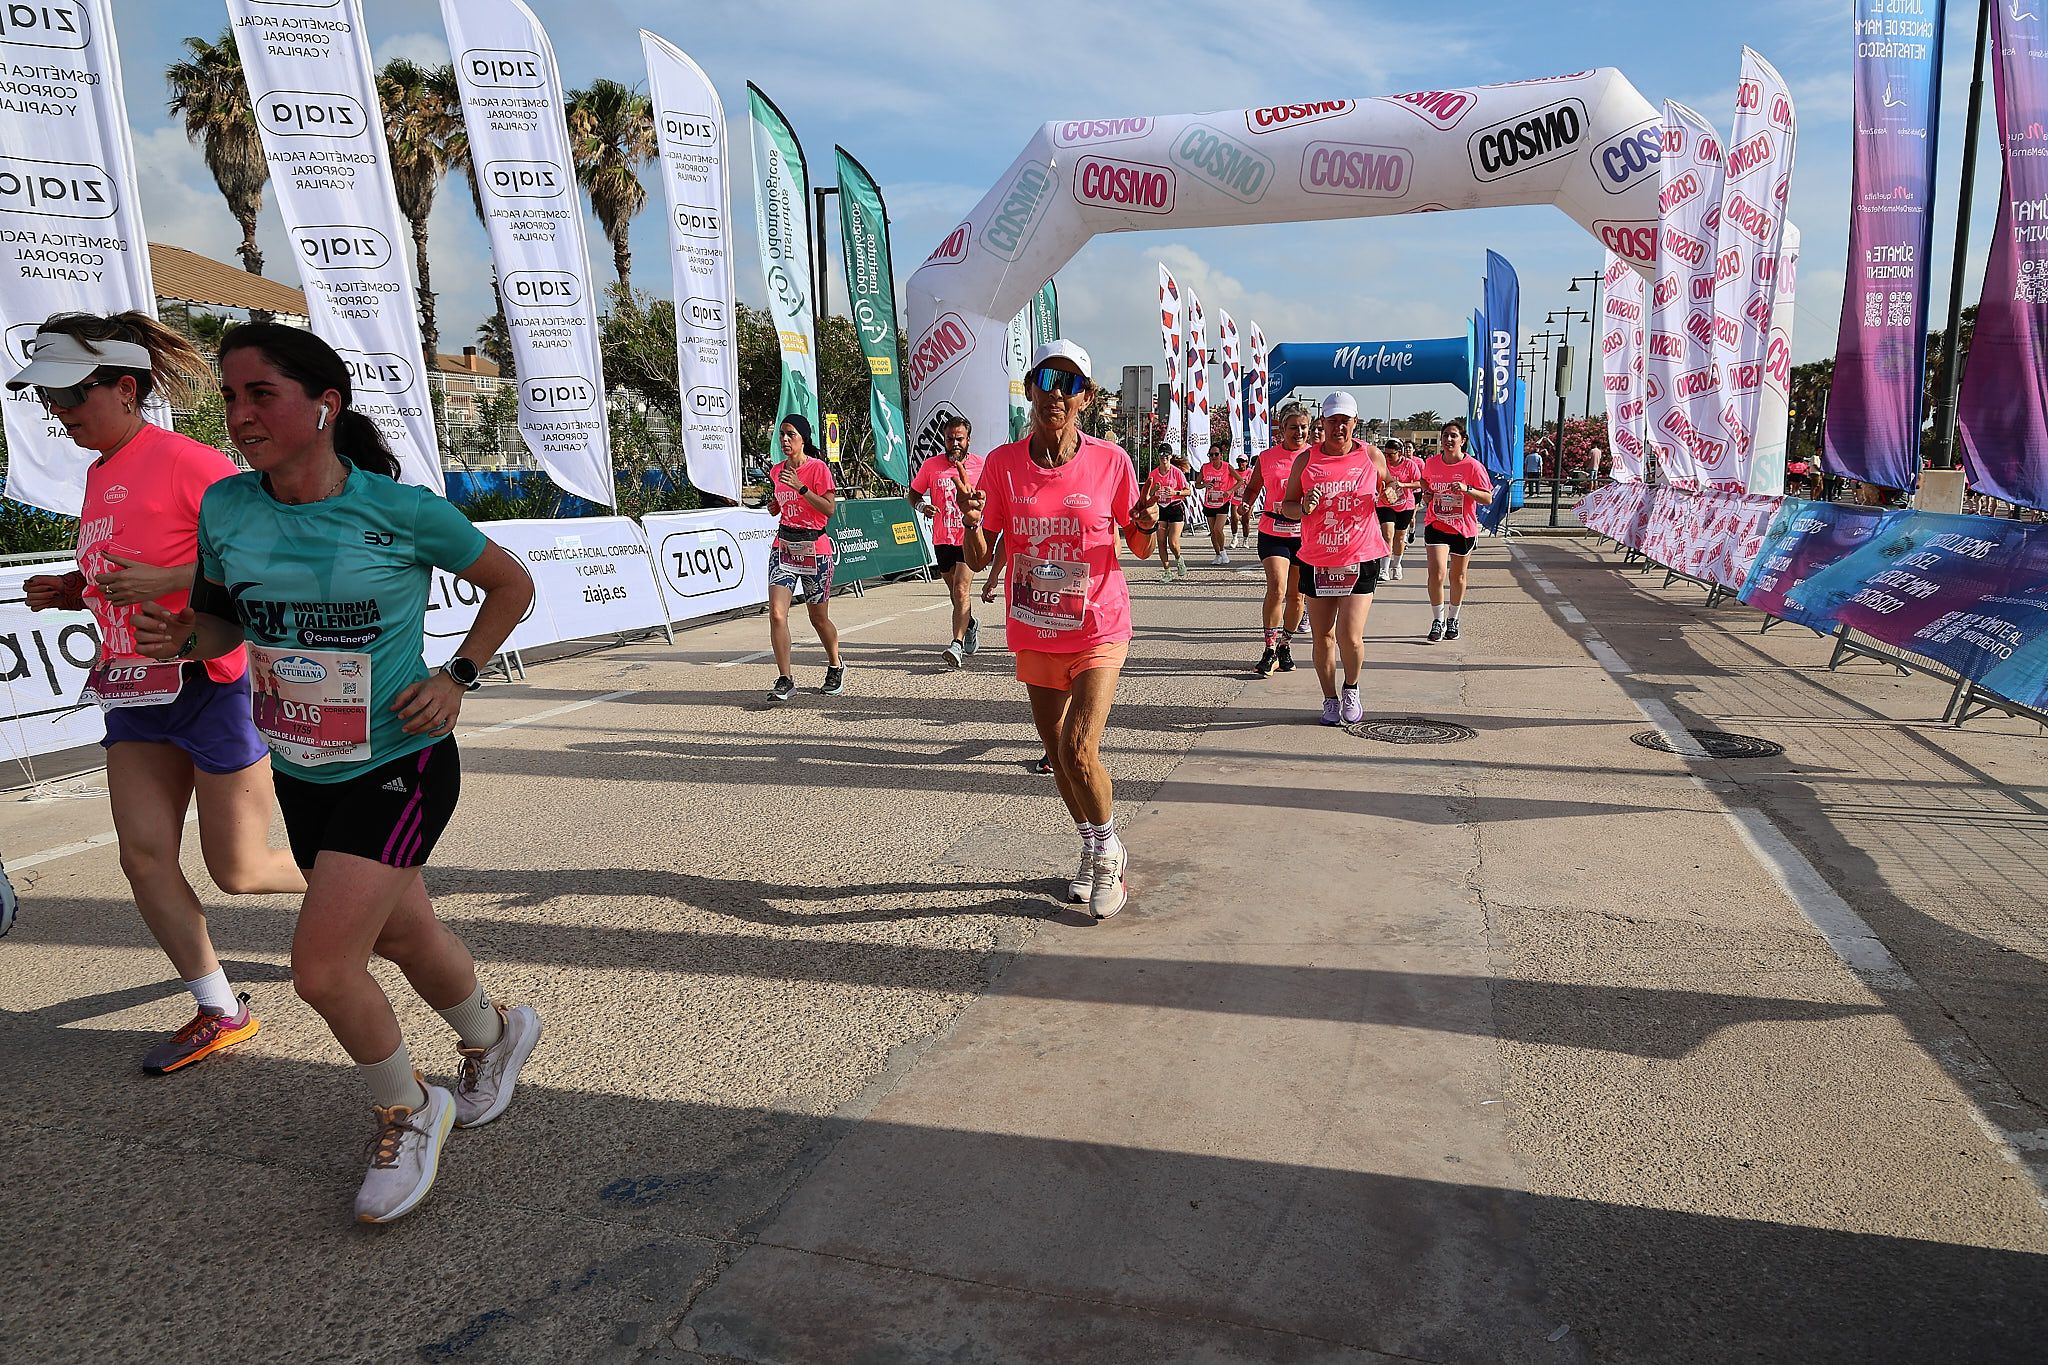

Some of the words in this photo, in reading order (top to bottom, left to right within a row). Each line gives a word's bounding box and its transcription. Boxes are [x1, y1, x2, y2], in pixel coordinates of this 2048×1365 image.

[1255, 99, 1346, 128] COSMO
[1061, 117, 1148, 142] COSMO
[1479, 105, 1580, 174] COSMO
[1180, 128, 1266, 197] COSMO
[1310, 147, 1404, 192] COSMO
[1082, 161, 1168, 208] COSMO
[987, 167, 1051, 252] COSMO
[910, 319, 967, 392] COSMO
[1332, 344, 1414, 380] Marlene
[1430, 482, 1451, 491] CARRE
[1337, 496, 1353, 512] DE
[1012, 516, 1081, 536] CARRERA
[1317, 532, 1350, 546] MUJER
[528, 546, 578, 562] COSMÉTICA
[577, 546, 608, 560] FACIAL,
[575, 566, 583, 577] Y
[583, 563, 617, 577] CAPILAR
[672, 545, 734, 583] ziaja
[1328, 573, 1346, 581] 016
[582, 583, 627, 605] ziaja.es
[1032, 590, 1061, 604] 016
[290, 598, 378, 614] NOCTURNA
[294, 610, 382, 629] VALENCIA
[315, 634, 339, 643] Gana
[340, 633, 376, 644] Energía
[1036, 629, 1058, 639] 2026
[1974, 614, 2017, 639] SÚMATE
[2005, 629, 2023, 647] AL
[1959, 629, 2013, 661] MOVIMIENTO
[107, 666, 148, 682] 016
[276, 665, 322, 679] ASTURIANA
[116, 683, 135, 691] 1922
[120, 690, 140, 698] MUJER
[282, 700, 322, 724] 016
[292, 723, 312, 736] 1759
[281, 732, 289, 740] DE
[289, 733, 296, 741] LA
[296, 735, 315, 745] MUJER
[320, 739, 353, 747] VALENCIA
[310, 747, 354, 761] Santander
